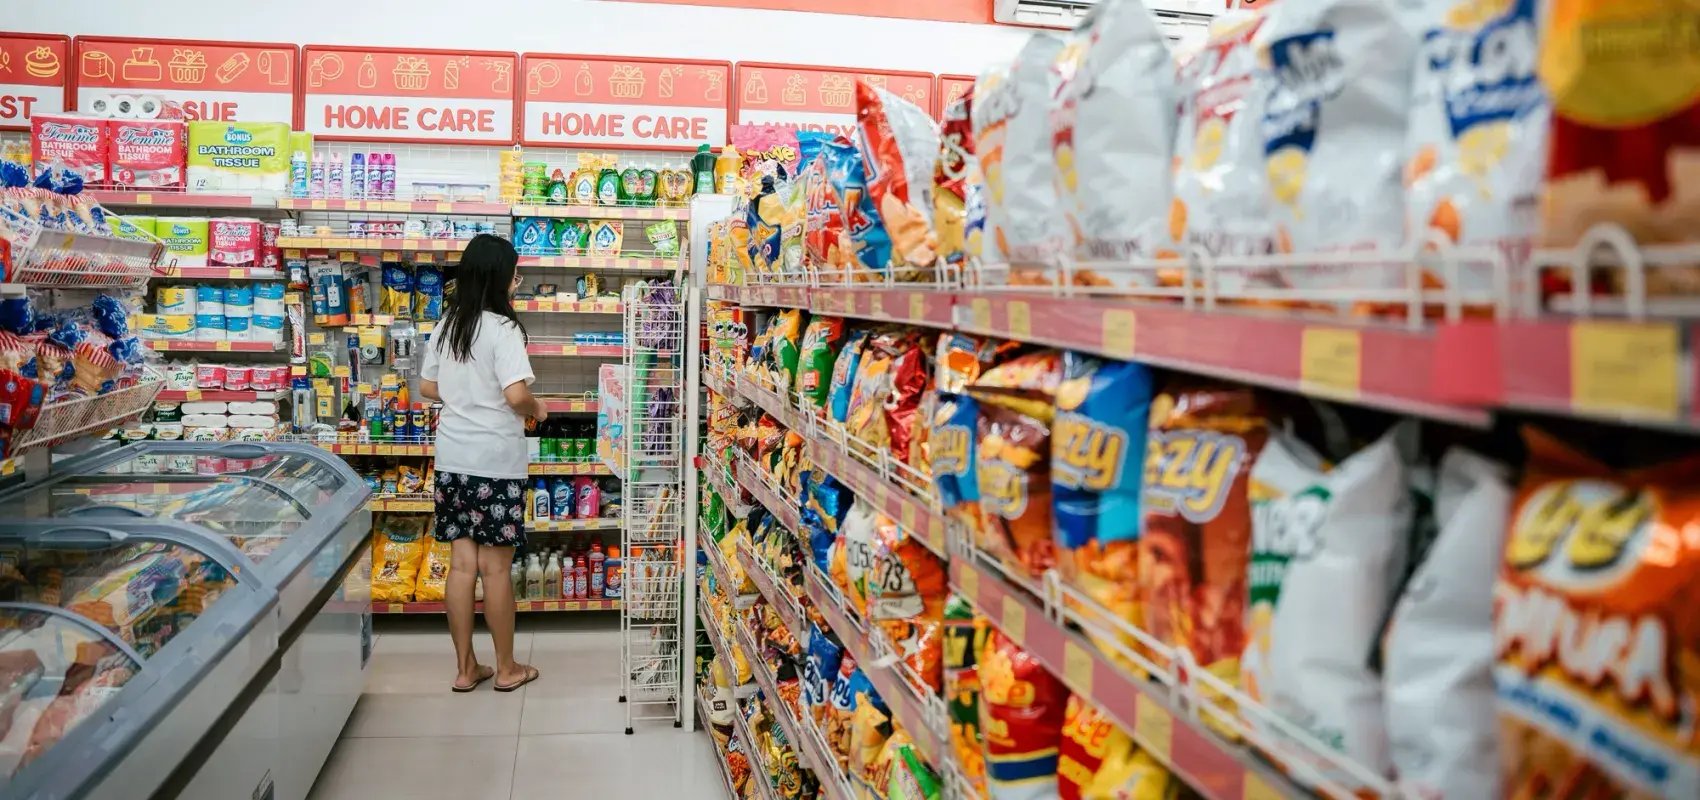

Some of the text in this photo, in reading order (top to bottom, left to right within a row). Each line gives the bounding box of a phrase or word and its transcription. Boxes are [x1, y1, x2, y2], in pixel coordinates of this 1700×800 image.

[182, 100, 238, 122] SUE
[324, 105, 495, 132] HOME CARE
[542, 112, 708, 140] HOME CARE
[39, 122, 99, 143] Femme
[115, 126, 175, 145] Femme
[226, 134, 251, 142] BONUS
[41, 141, 97, 152] BATHROOM
[118, 145, 173, 154] BATHROOM
[199, 145, 275, 156] BATHROOM
[41, 149, 74, 158] TISSUE
[213, 157, 260, 168] TISSUE
[124, 171, 131, 180] 9
